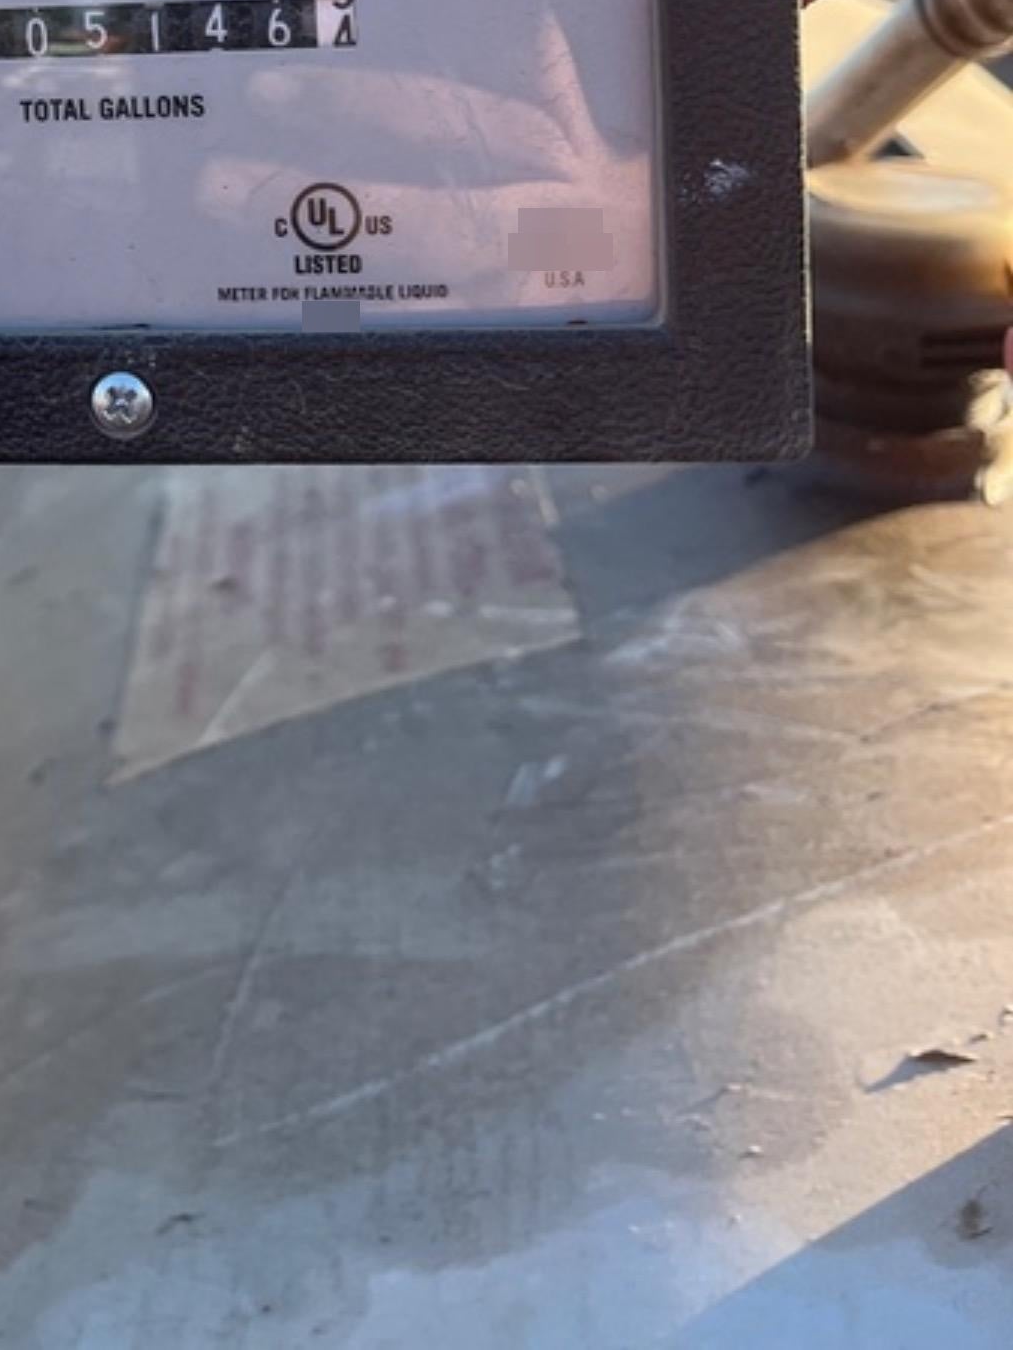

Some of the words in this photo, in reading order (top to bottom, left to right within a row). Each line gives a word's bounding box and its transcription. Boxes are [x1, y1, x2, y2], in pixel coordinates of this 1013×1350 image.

[20, 98, 91, 122] TOTAL
[100, 95, 206, 119] GALLONS
[366, 215, 393, 235] US
[295, 254, 363, 275] LISTED
[218, 287, 267, 301] METER
[272, 287, 300, 301] FOR
[399, 283, 448, 301] LIQUID
